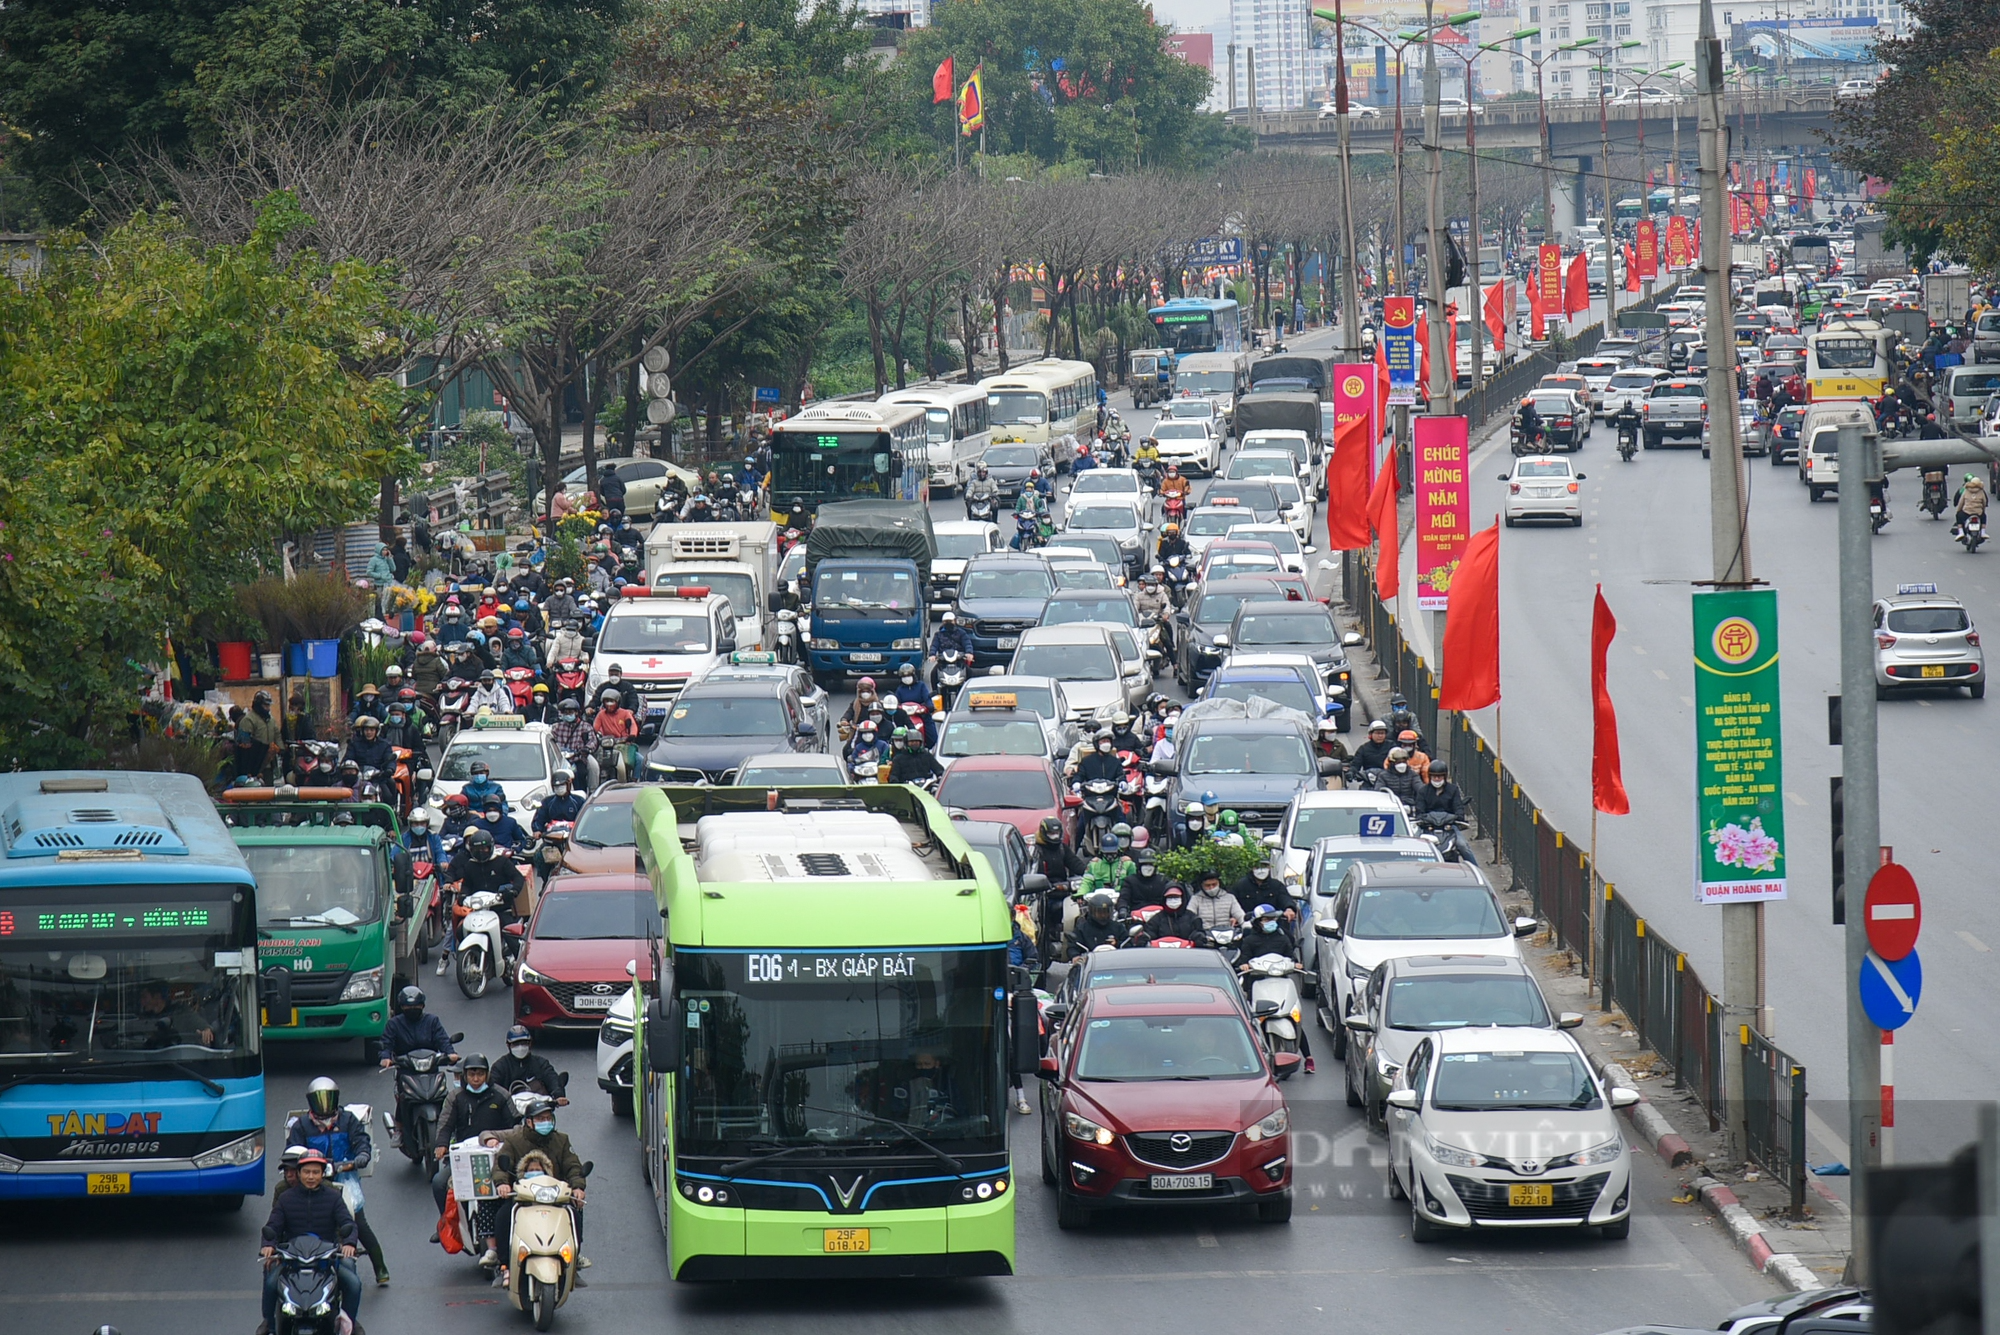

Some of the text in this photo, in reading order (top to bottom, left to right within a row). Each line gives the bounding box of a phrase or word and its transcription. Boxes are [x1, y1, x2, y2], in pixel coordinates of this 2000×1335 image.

[1423, 444, 1461, 461] CHÚC
[1423, 467, 1462, 483] MỪNG
[1428, 489, 1458, 506] NĂM
[1431, 511, 1456, 528] MỚI
[1368, 816, 1387, 834] G7
[1706, 883, 1782, 897] QUẬN HOÀNG MAI
[297, 938, 321, 946] ANH
[259, 947, 302, 956] OGISTICS
[294, 957, 313, 972] HỘ
[749, 954, 782, 982] E06
[816, 958, 838, 977] BX
[842, 953, 878, 977] GIÁP
[100, 1174, 118, 1184] 29B
[92, 1184, 126, 1193] 209.52
[1520, 1186, 1541, 1195] 30G
[1513, 1196, 1548, 1206] 622.18
[837, 1230, 856, 1240] 29F
[829, 1241, 865, 1250] 018.12
